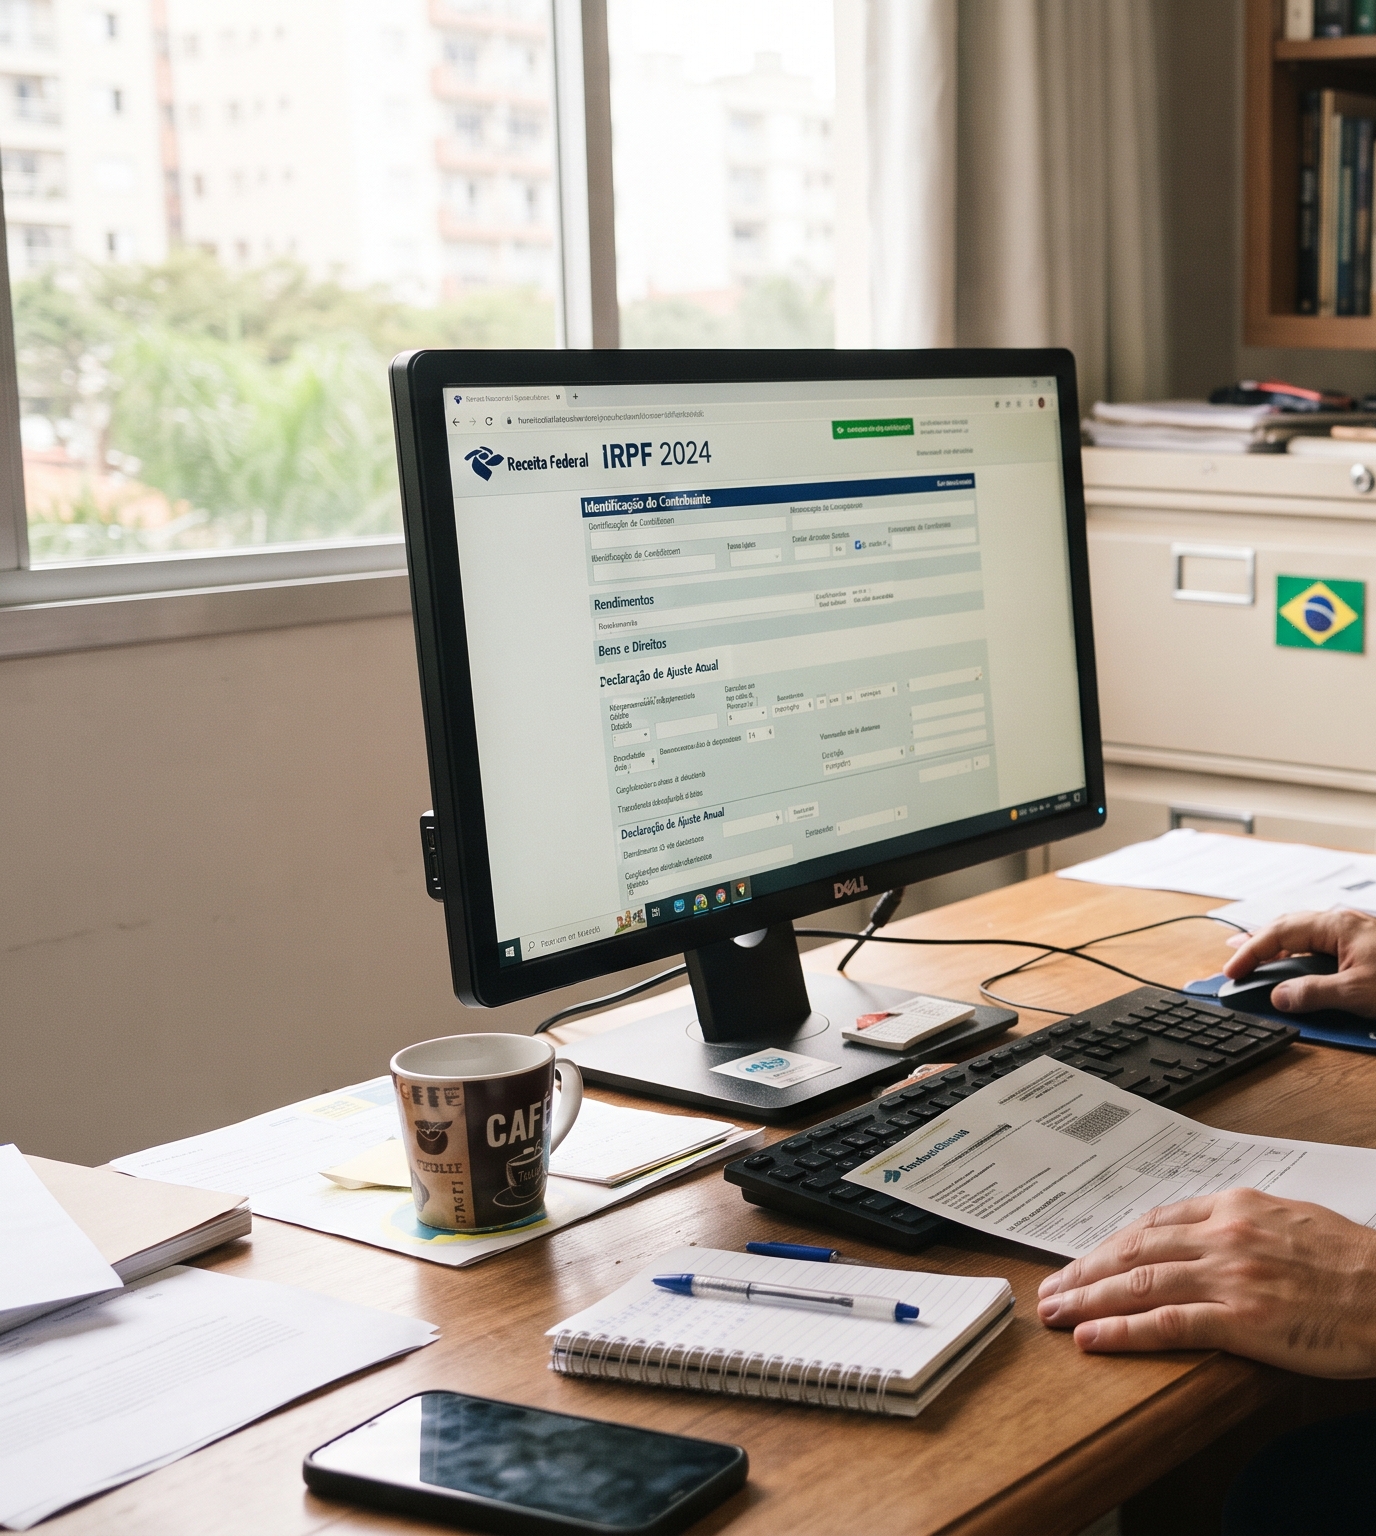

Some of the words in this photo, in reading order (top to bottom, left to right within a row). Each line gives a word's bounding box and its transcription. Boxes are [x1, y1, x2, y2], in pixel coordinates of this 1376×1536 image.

[507, 454, 546, 470] Receita
[550, 452, 588, 468] Federal
[602, 442, 651, 468] IRPF
[659, 440, 711, 465] 2024
[646, 496, 656, 508] do
[594, 595, 653, 610] Rendimentos
[598, 645, 620, 656] Bens
[624, 645, 629, 653] e
[632, 638, 666, 652] Direitos
[653, 667, 663, 678] de
[666, 663, 692, 679] Ajuste
[666, 818, 675, 829] de
[677, 813, 700, 828] Ajuste
[703, 806, 724, 820] Anual
[833, 875, 869, 899] DELL
